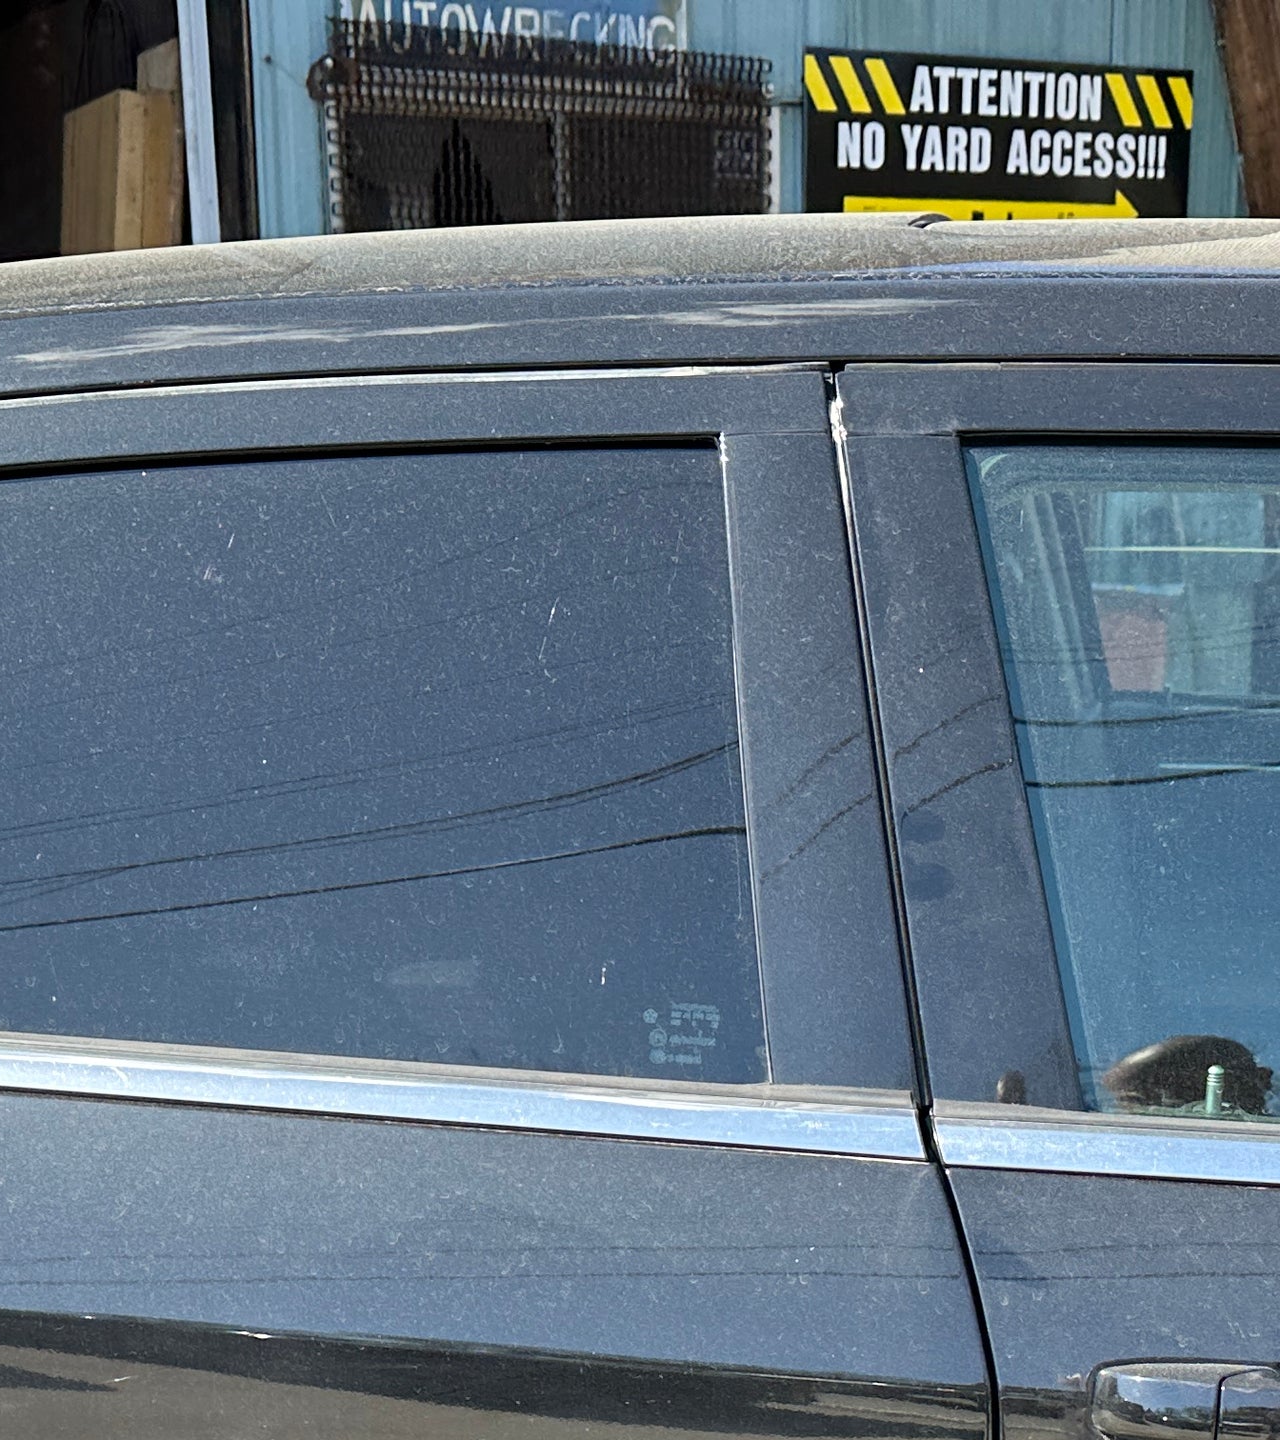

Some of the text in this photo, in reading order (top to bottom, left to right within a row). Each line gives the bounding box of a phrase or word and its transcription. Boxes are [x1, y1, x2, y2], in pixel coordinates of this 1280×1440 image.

[909, 65, 1102, 122] ATTENTION
[837, 121, 1168, 180] NO YARD ACCESS!!!
